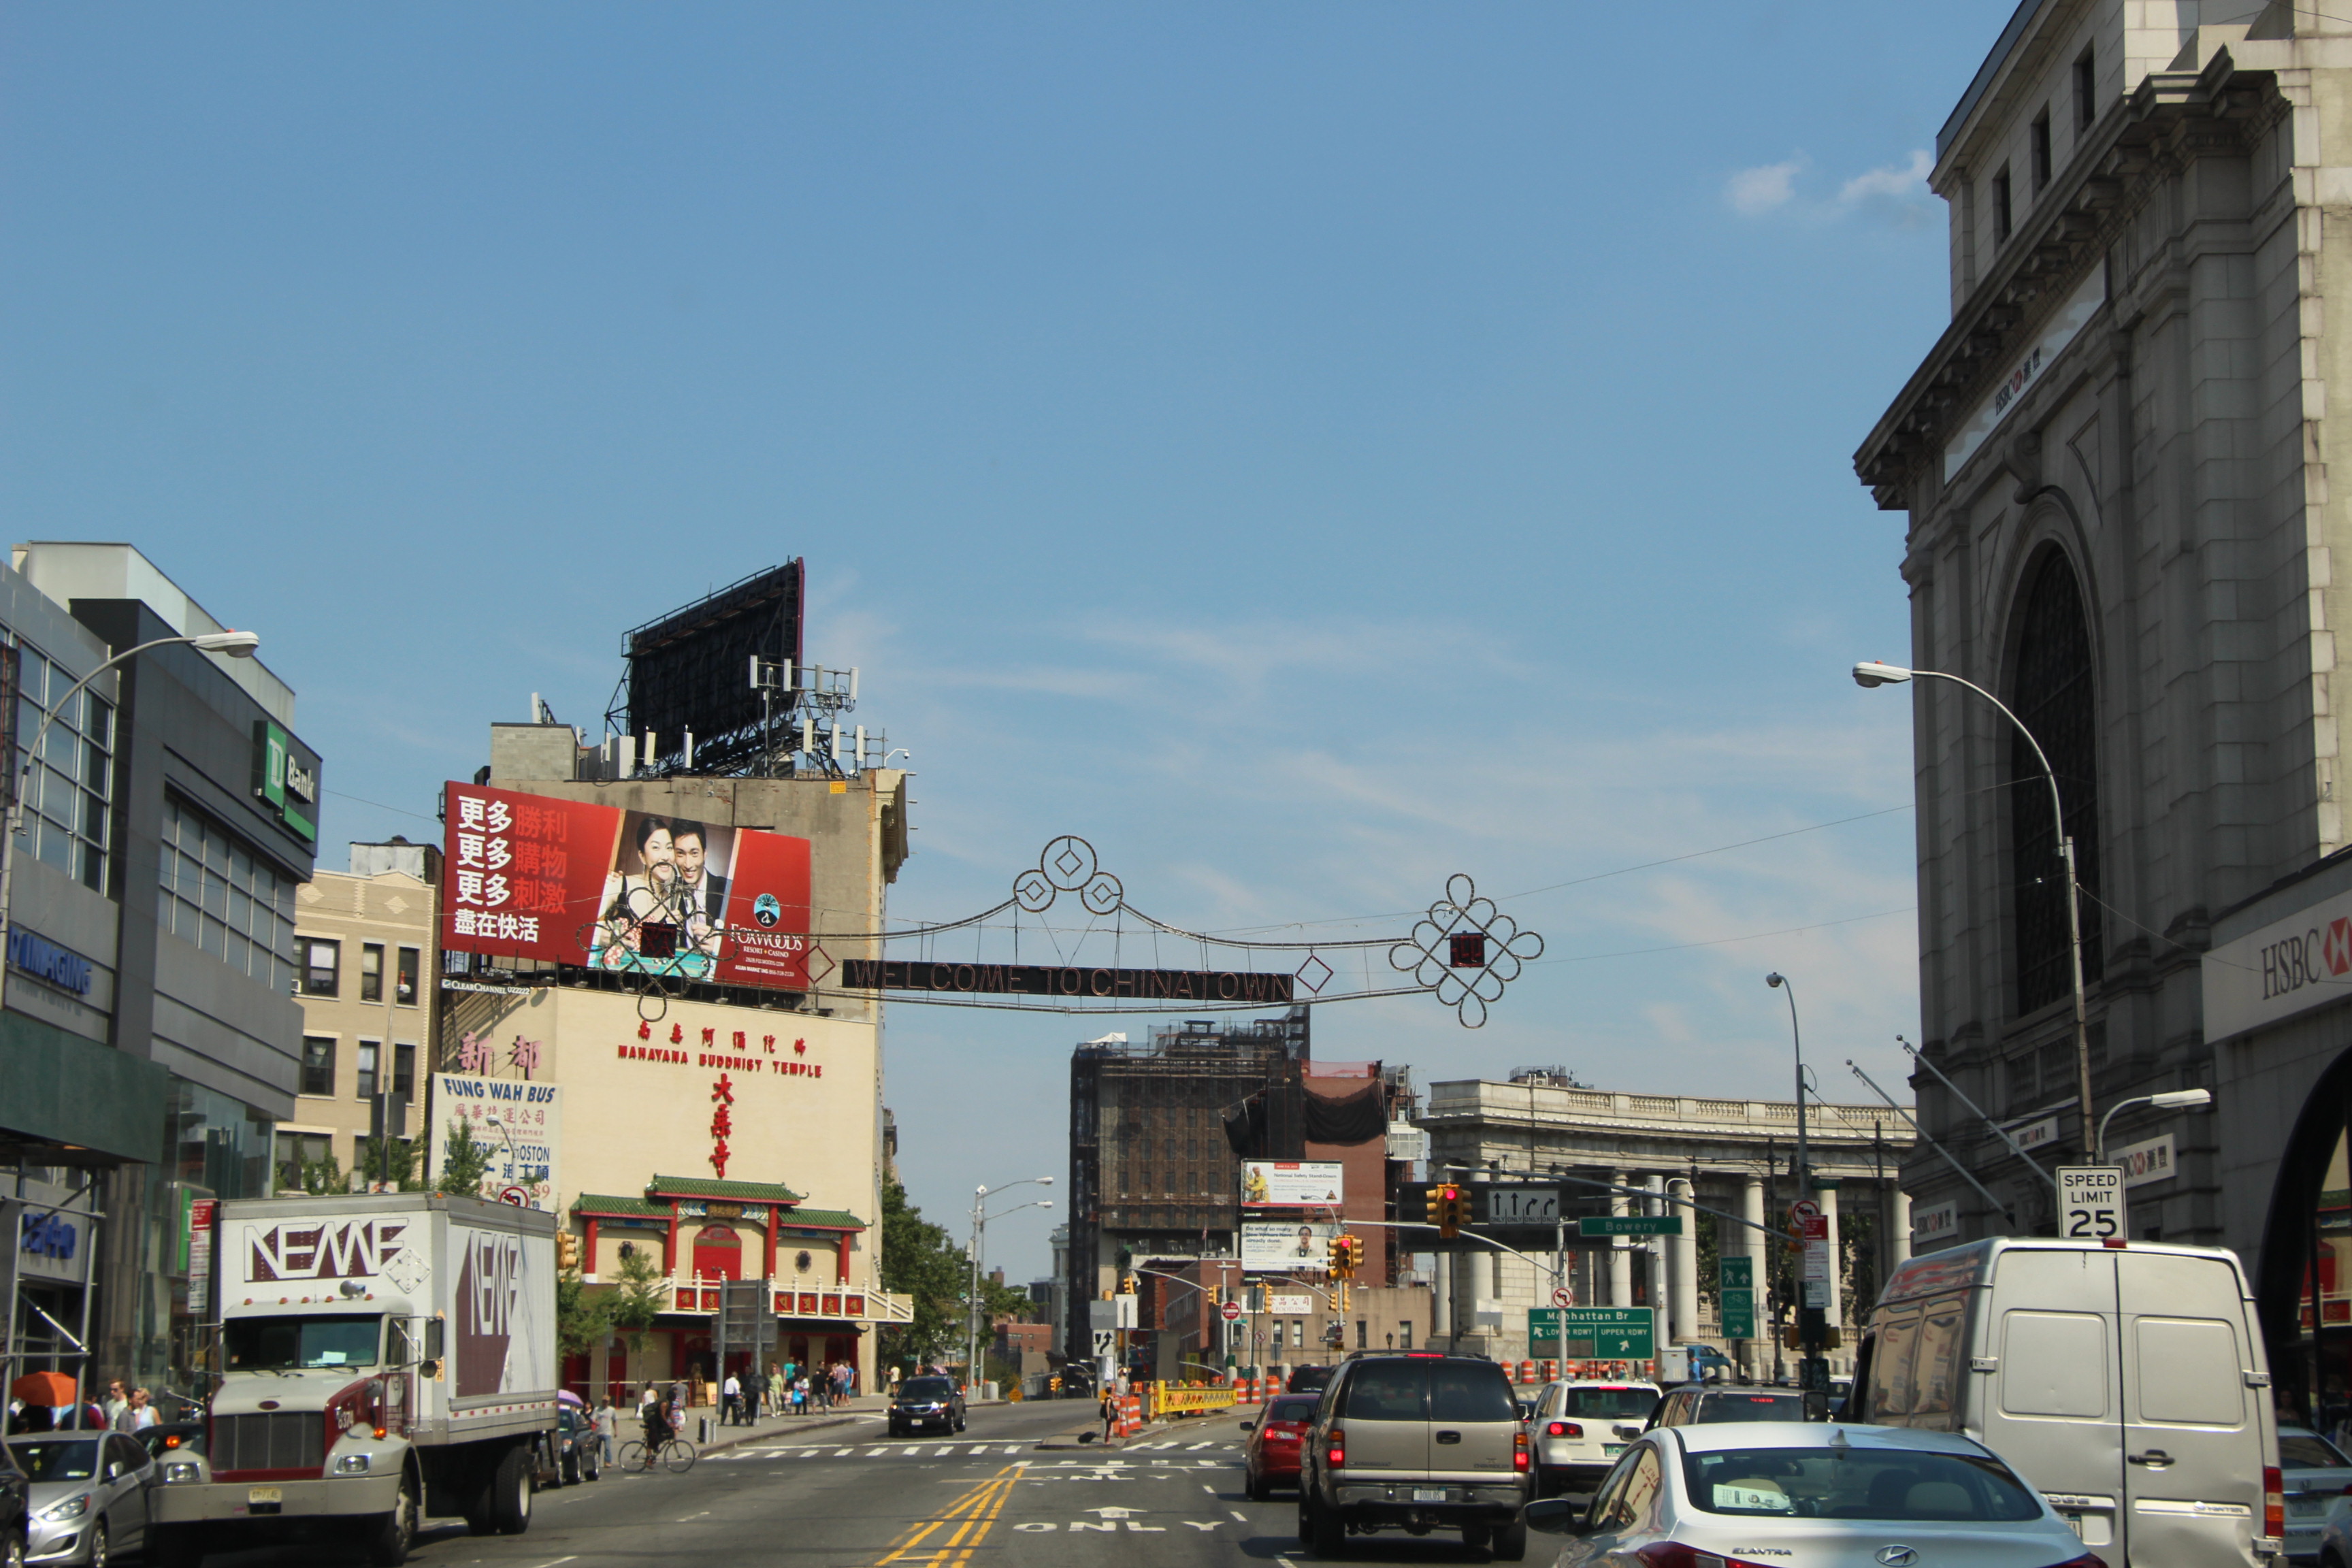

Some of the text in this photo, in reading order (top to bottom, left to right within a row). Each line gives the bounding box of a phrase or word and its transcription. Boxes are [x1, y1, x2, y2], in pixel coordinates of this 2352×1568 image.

[1995, 378, 2013, 416] HSBC
[269, 737, 314, 803] TD Bank
[458, 795, 568, 843] 更多勝利
[457, 832, 568, 879] 更多購物
[456, 869, 567, 915] 更多刺激
[454, 908, 539, 943] 盡在快活
[730, 923, 802, 951] FOXWOODS
[20, 933, 93, 995] IMAGING
[743, 946, 789, 958] RESORT CASINO
[2261, 927, 2321, 1000] HSBC
[852, 960, 1292, 1002] WELCOME TO CHINATOWN
[618, 1045, 822, 1078] MAHAYANA BUDDHIST TEMPLE
[444, 1079, 555, 1103] FUNG WAH BUS
[708, 1073, 734, 1178] 大乘寺
[471, 1141, 495, 1159] ORK
[2064, 1175, 2117, 1187] SPEED
[2071, 1192, 2112, 1203] LIMIT
[1605, 1222, 1657, 1232] Bowery
[2069, 1209, 2117, 1237] 25
[244, 1218, 409, 1283] NEMF
[1616, 1311, 1629, 1320] Br
[1419, 1490, 1440, 1500] DOULOS
[2042, 1495, 2090, 1505] DGE
[1013, 1521, 1225, 1531] ONLY
[1732, 1548, 1792, 1556] ELANTRA
